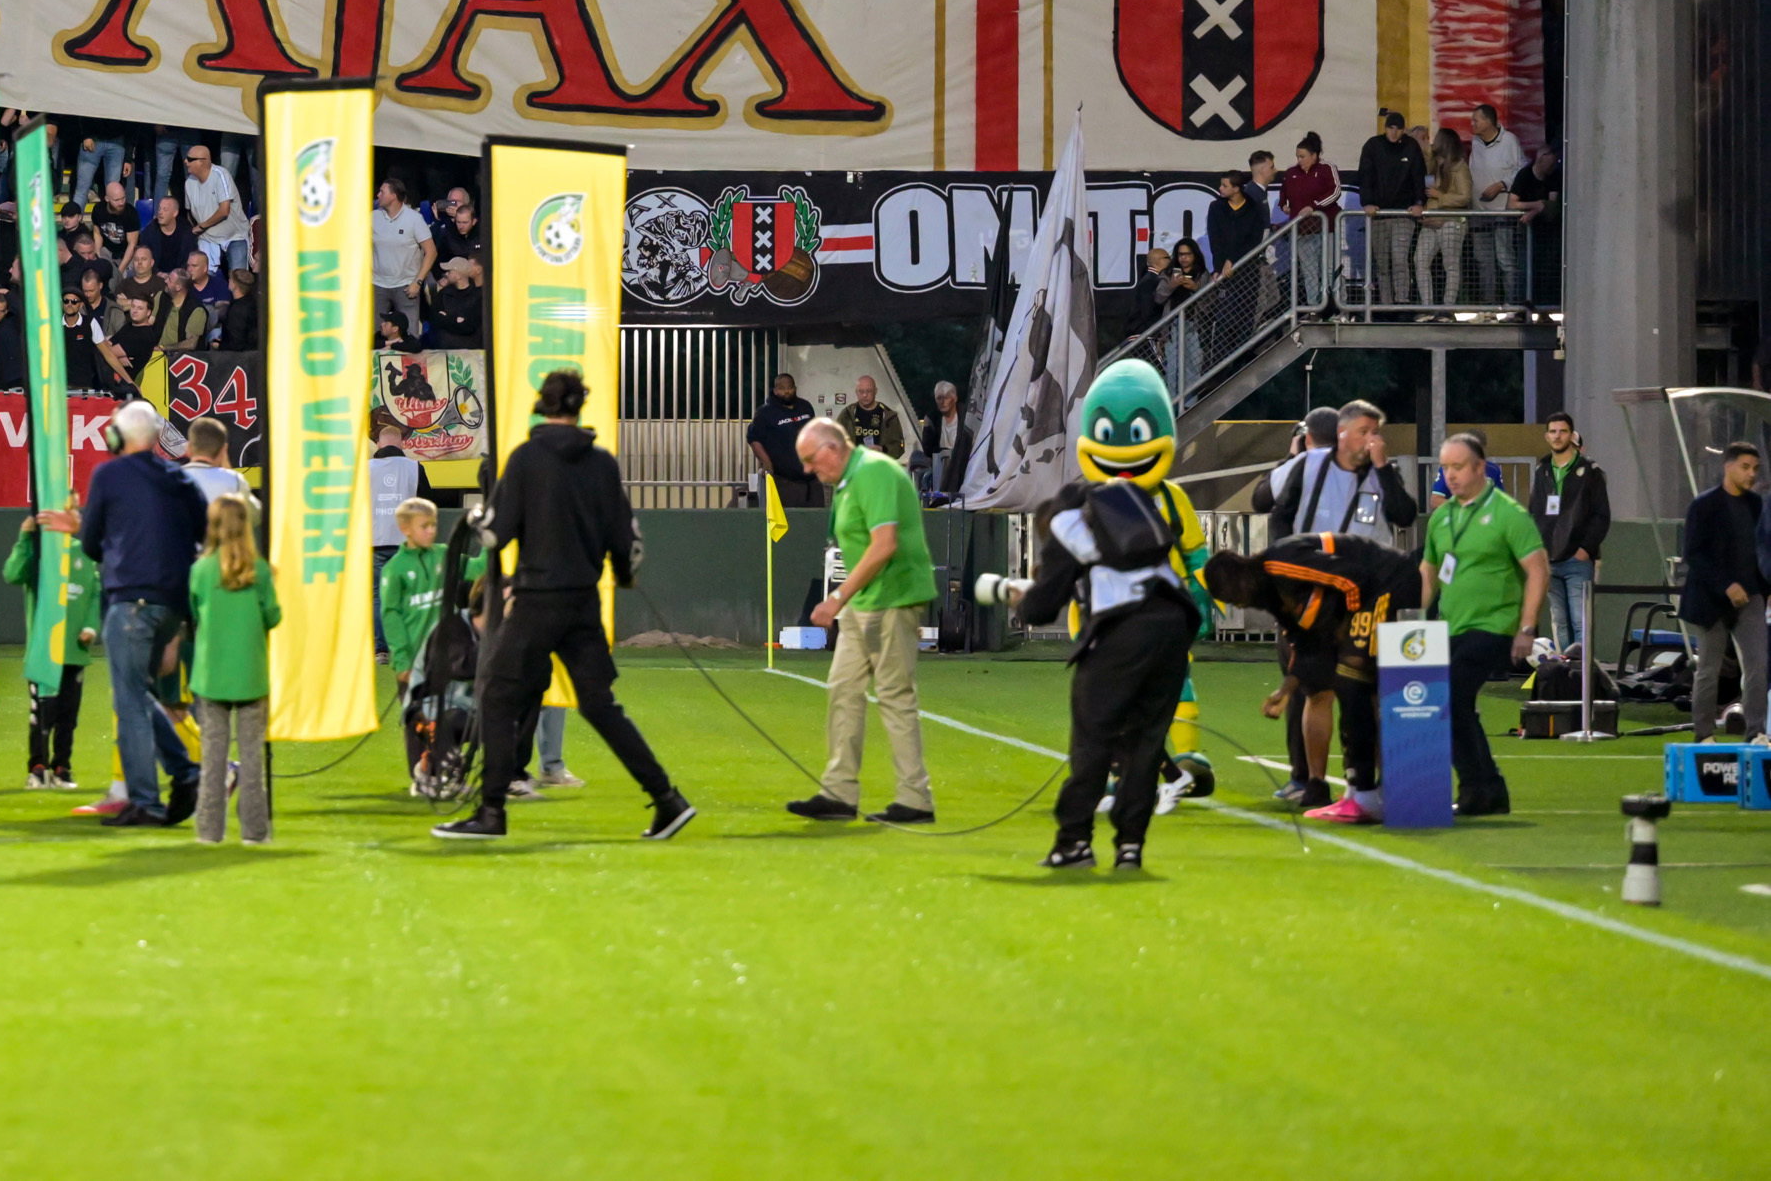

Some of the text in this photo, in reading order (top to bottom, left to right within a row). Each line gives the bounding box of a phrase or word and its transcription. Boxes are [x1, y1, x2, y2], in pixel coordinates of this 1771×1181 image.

[297, 250, 347, 377] NAO
[169, 354, 258, 431] 34
[402, 432, 474, 449] sterdam
[301, 397, 355, 585] VEURE
[1349, 612, 1372, 637] 99
[1702, 762, 1739, 775] POWE
